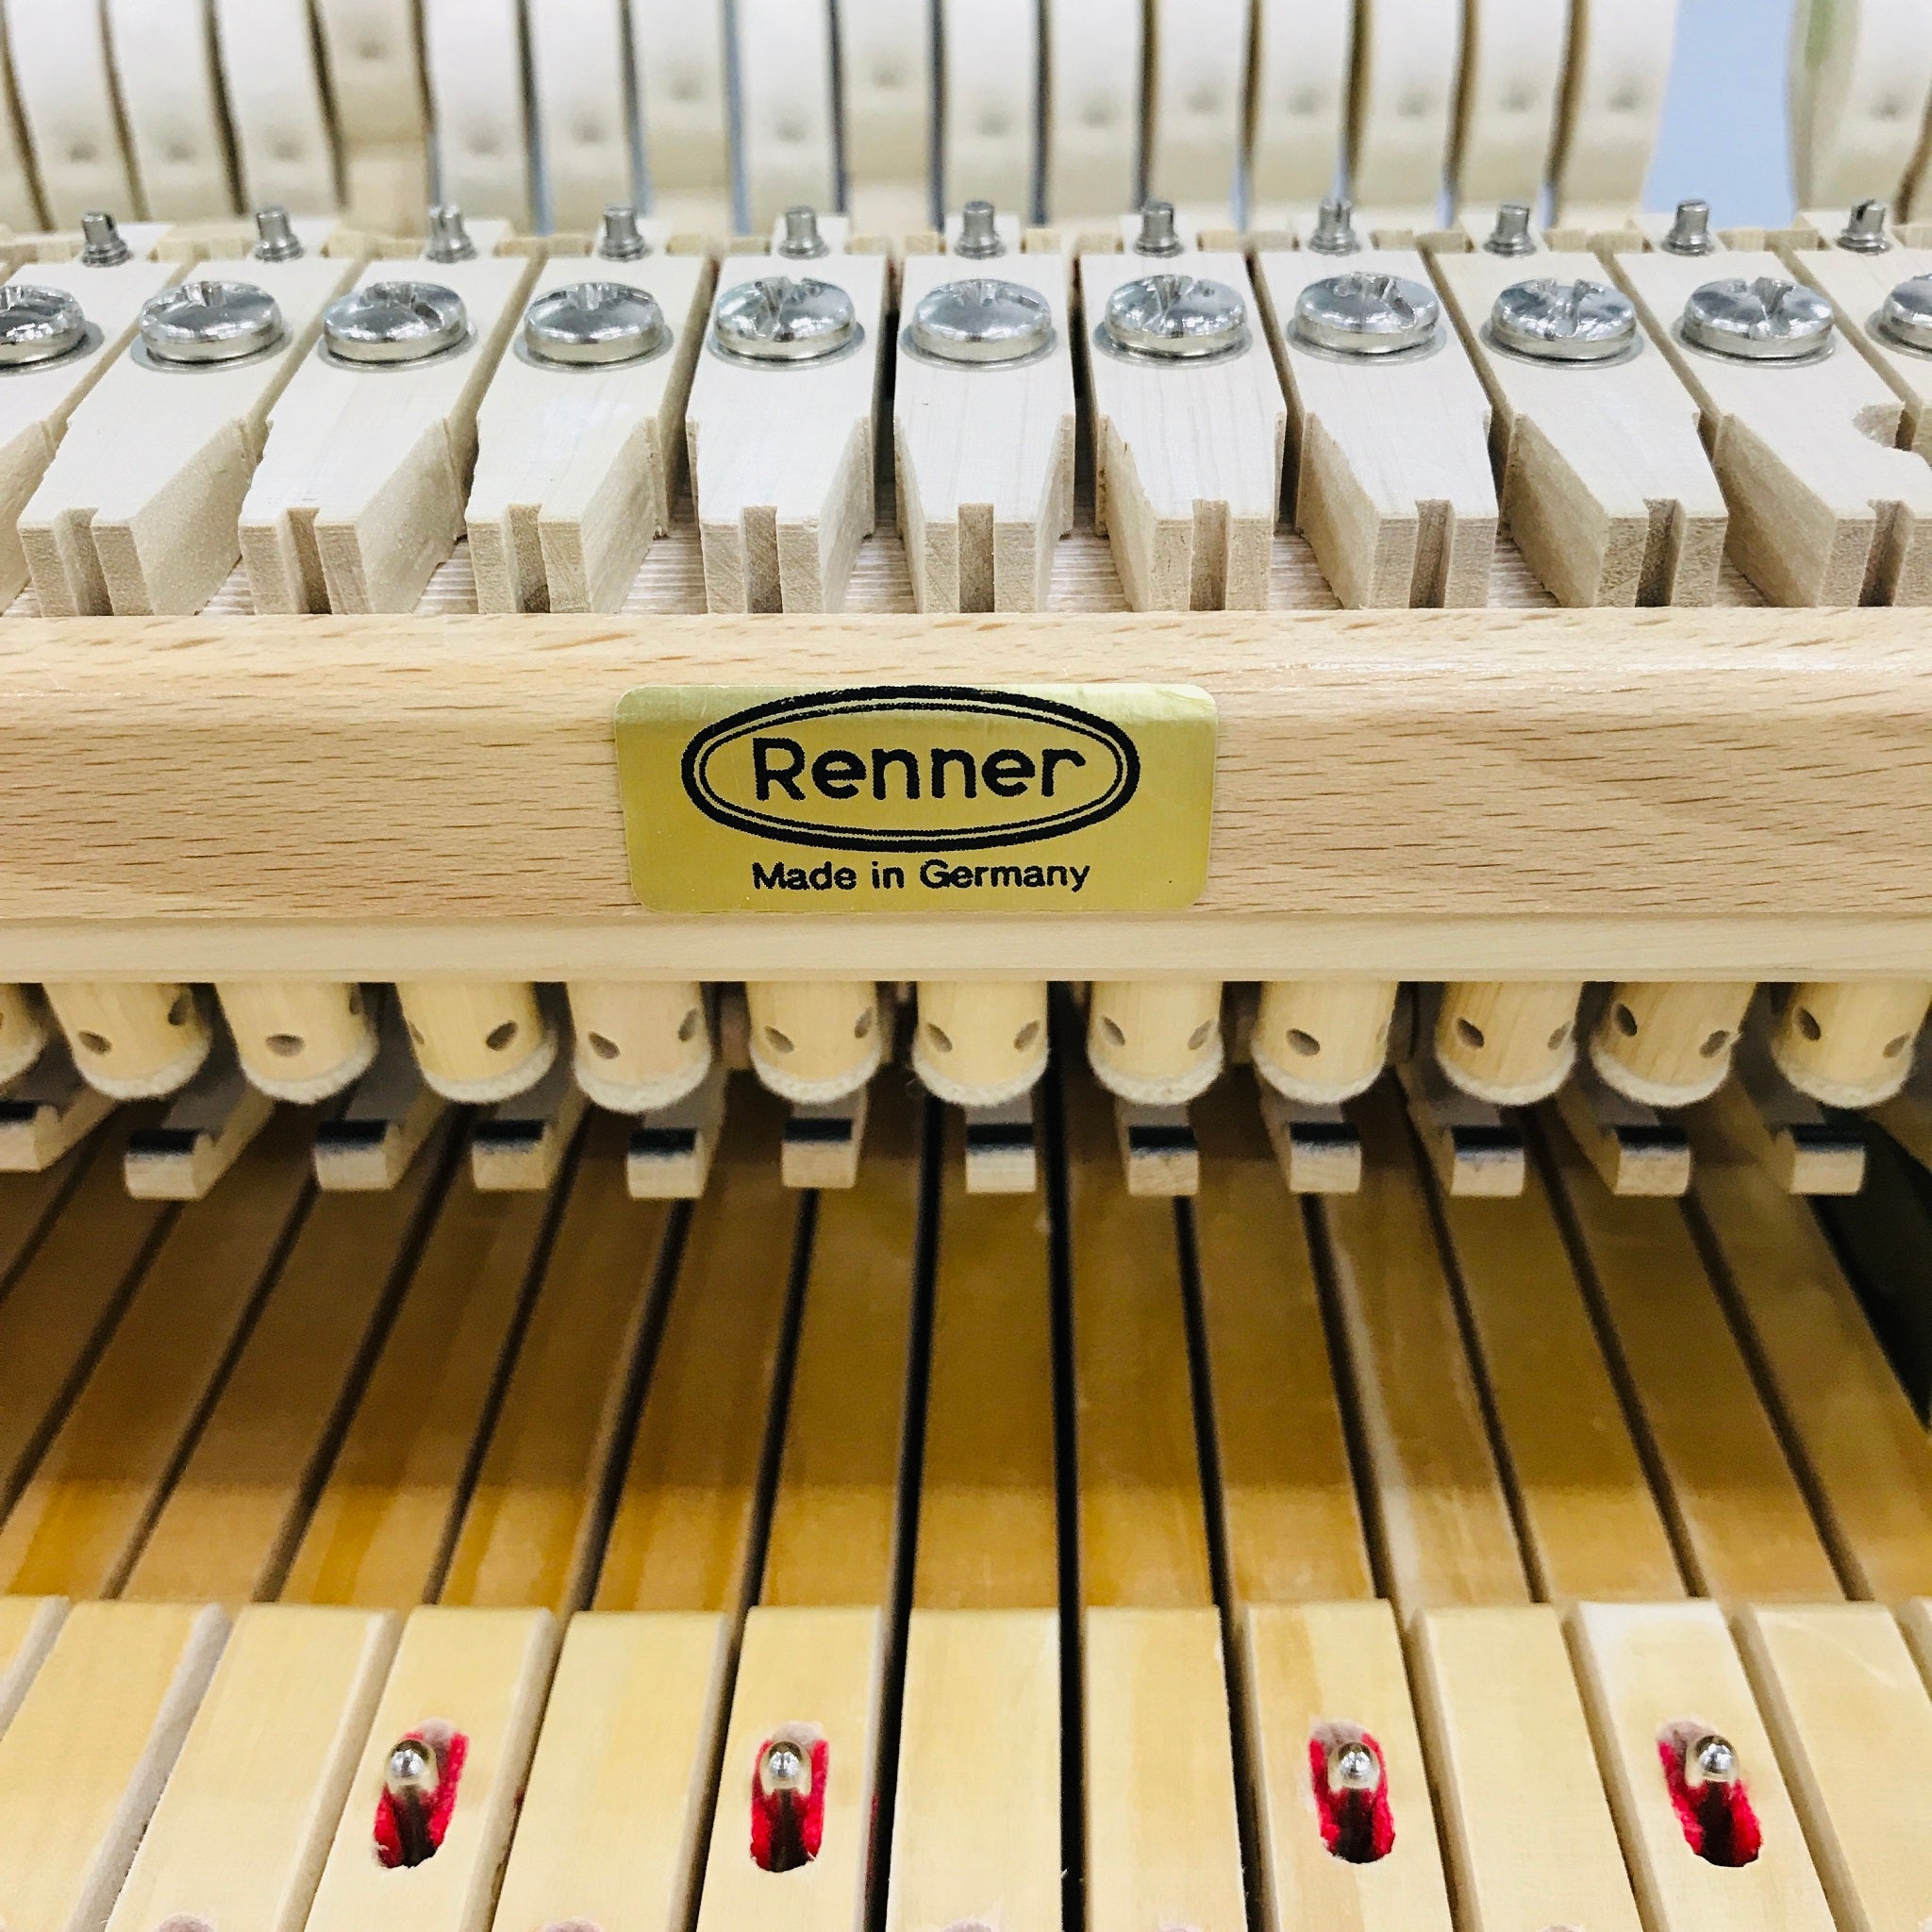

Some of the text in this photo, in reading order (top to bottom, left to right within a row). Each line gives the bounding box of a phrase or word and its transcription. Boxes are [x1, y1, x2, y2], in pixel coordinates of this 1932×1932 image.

[752, 737, 1087, 802] Renner
[752, 859, 1091, 893] Made in Germany
